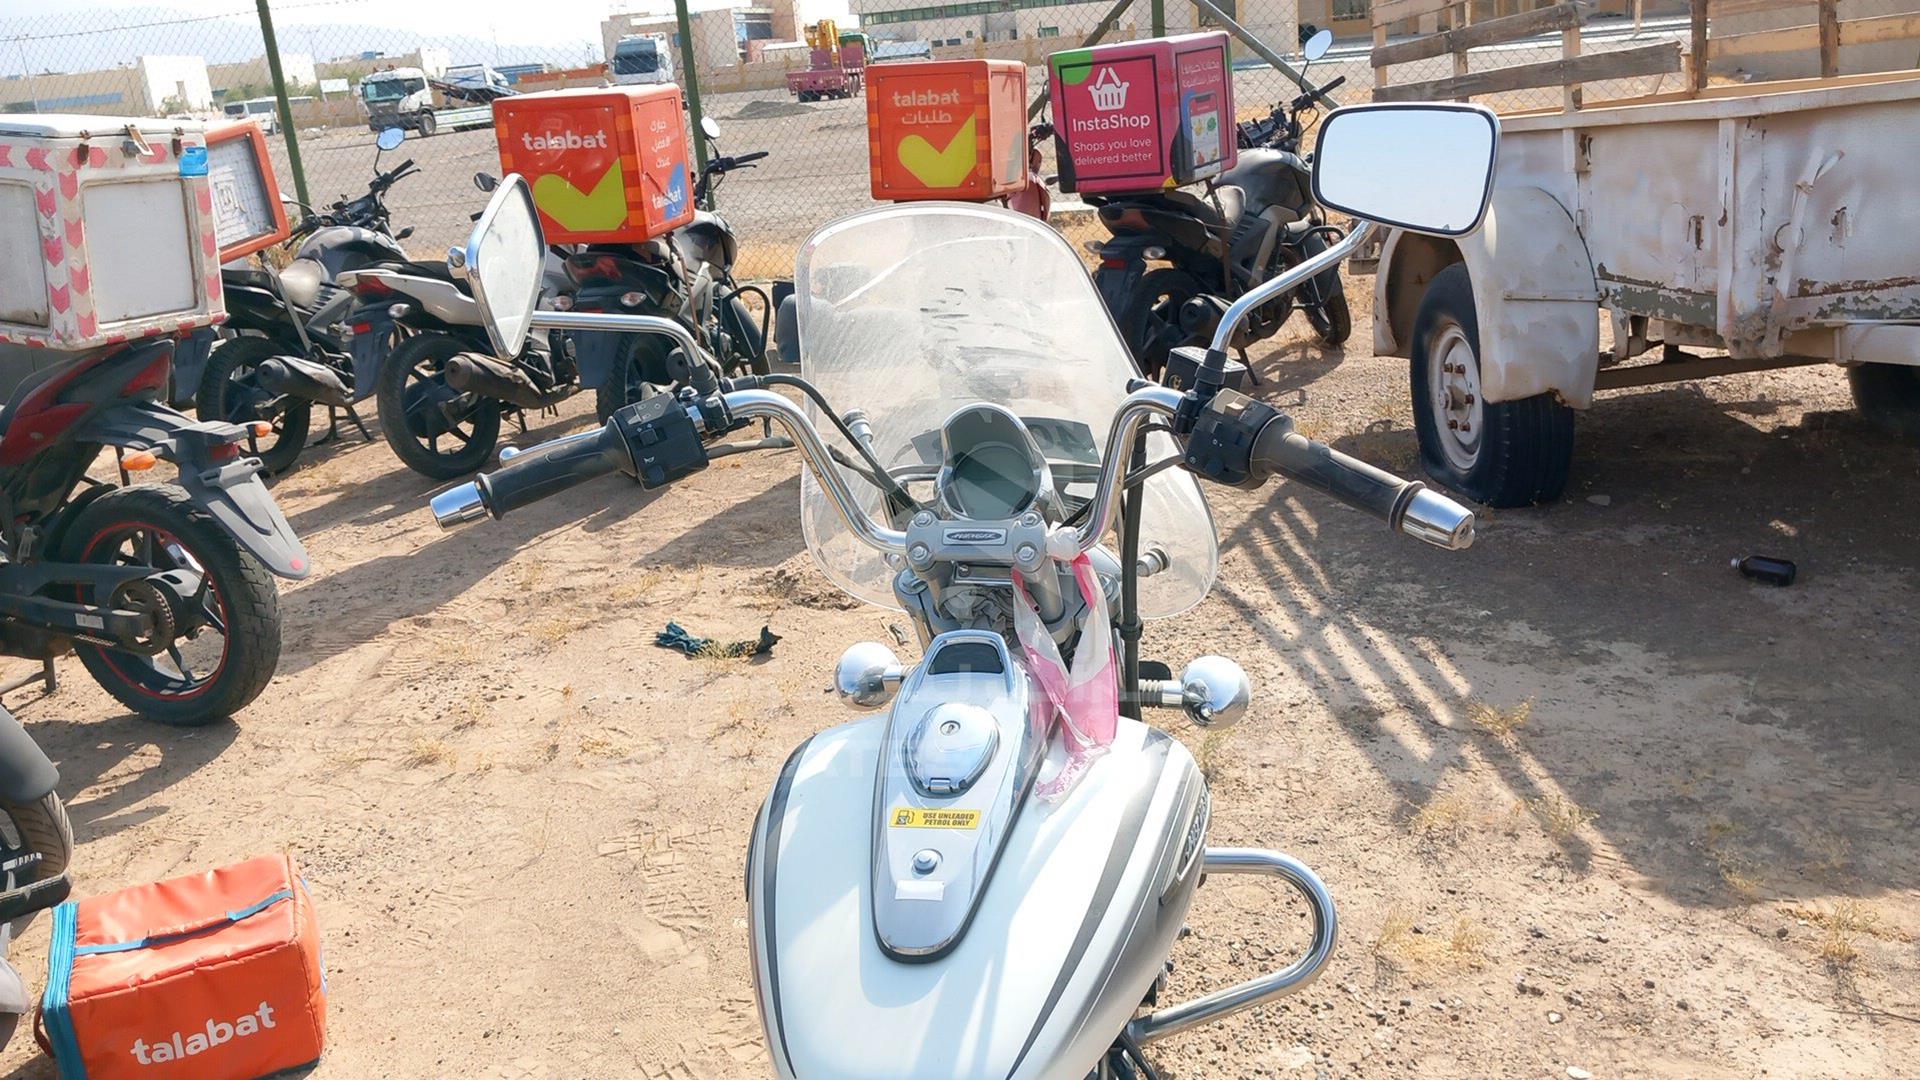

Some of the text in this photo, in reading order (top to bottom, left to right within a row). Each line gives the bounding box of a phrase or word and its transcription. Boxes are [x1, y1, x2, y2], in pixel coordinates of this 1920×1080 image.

[892, 88, 960, 107] talabat
[901, 110, 953, 128] طلبات
[1072, 113, 1151, 132] InstaShop
[522, 130, 608, 151] talabat
[1074, 137, 1152, 154] Shops you love
[1075, 153, 1152, 166] delivered better
[130, 1001, 277, 1066] talabat
